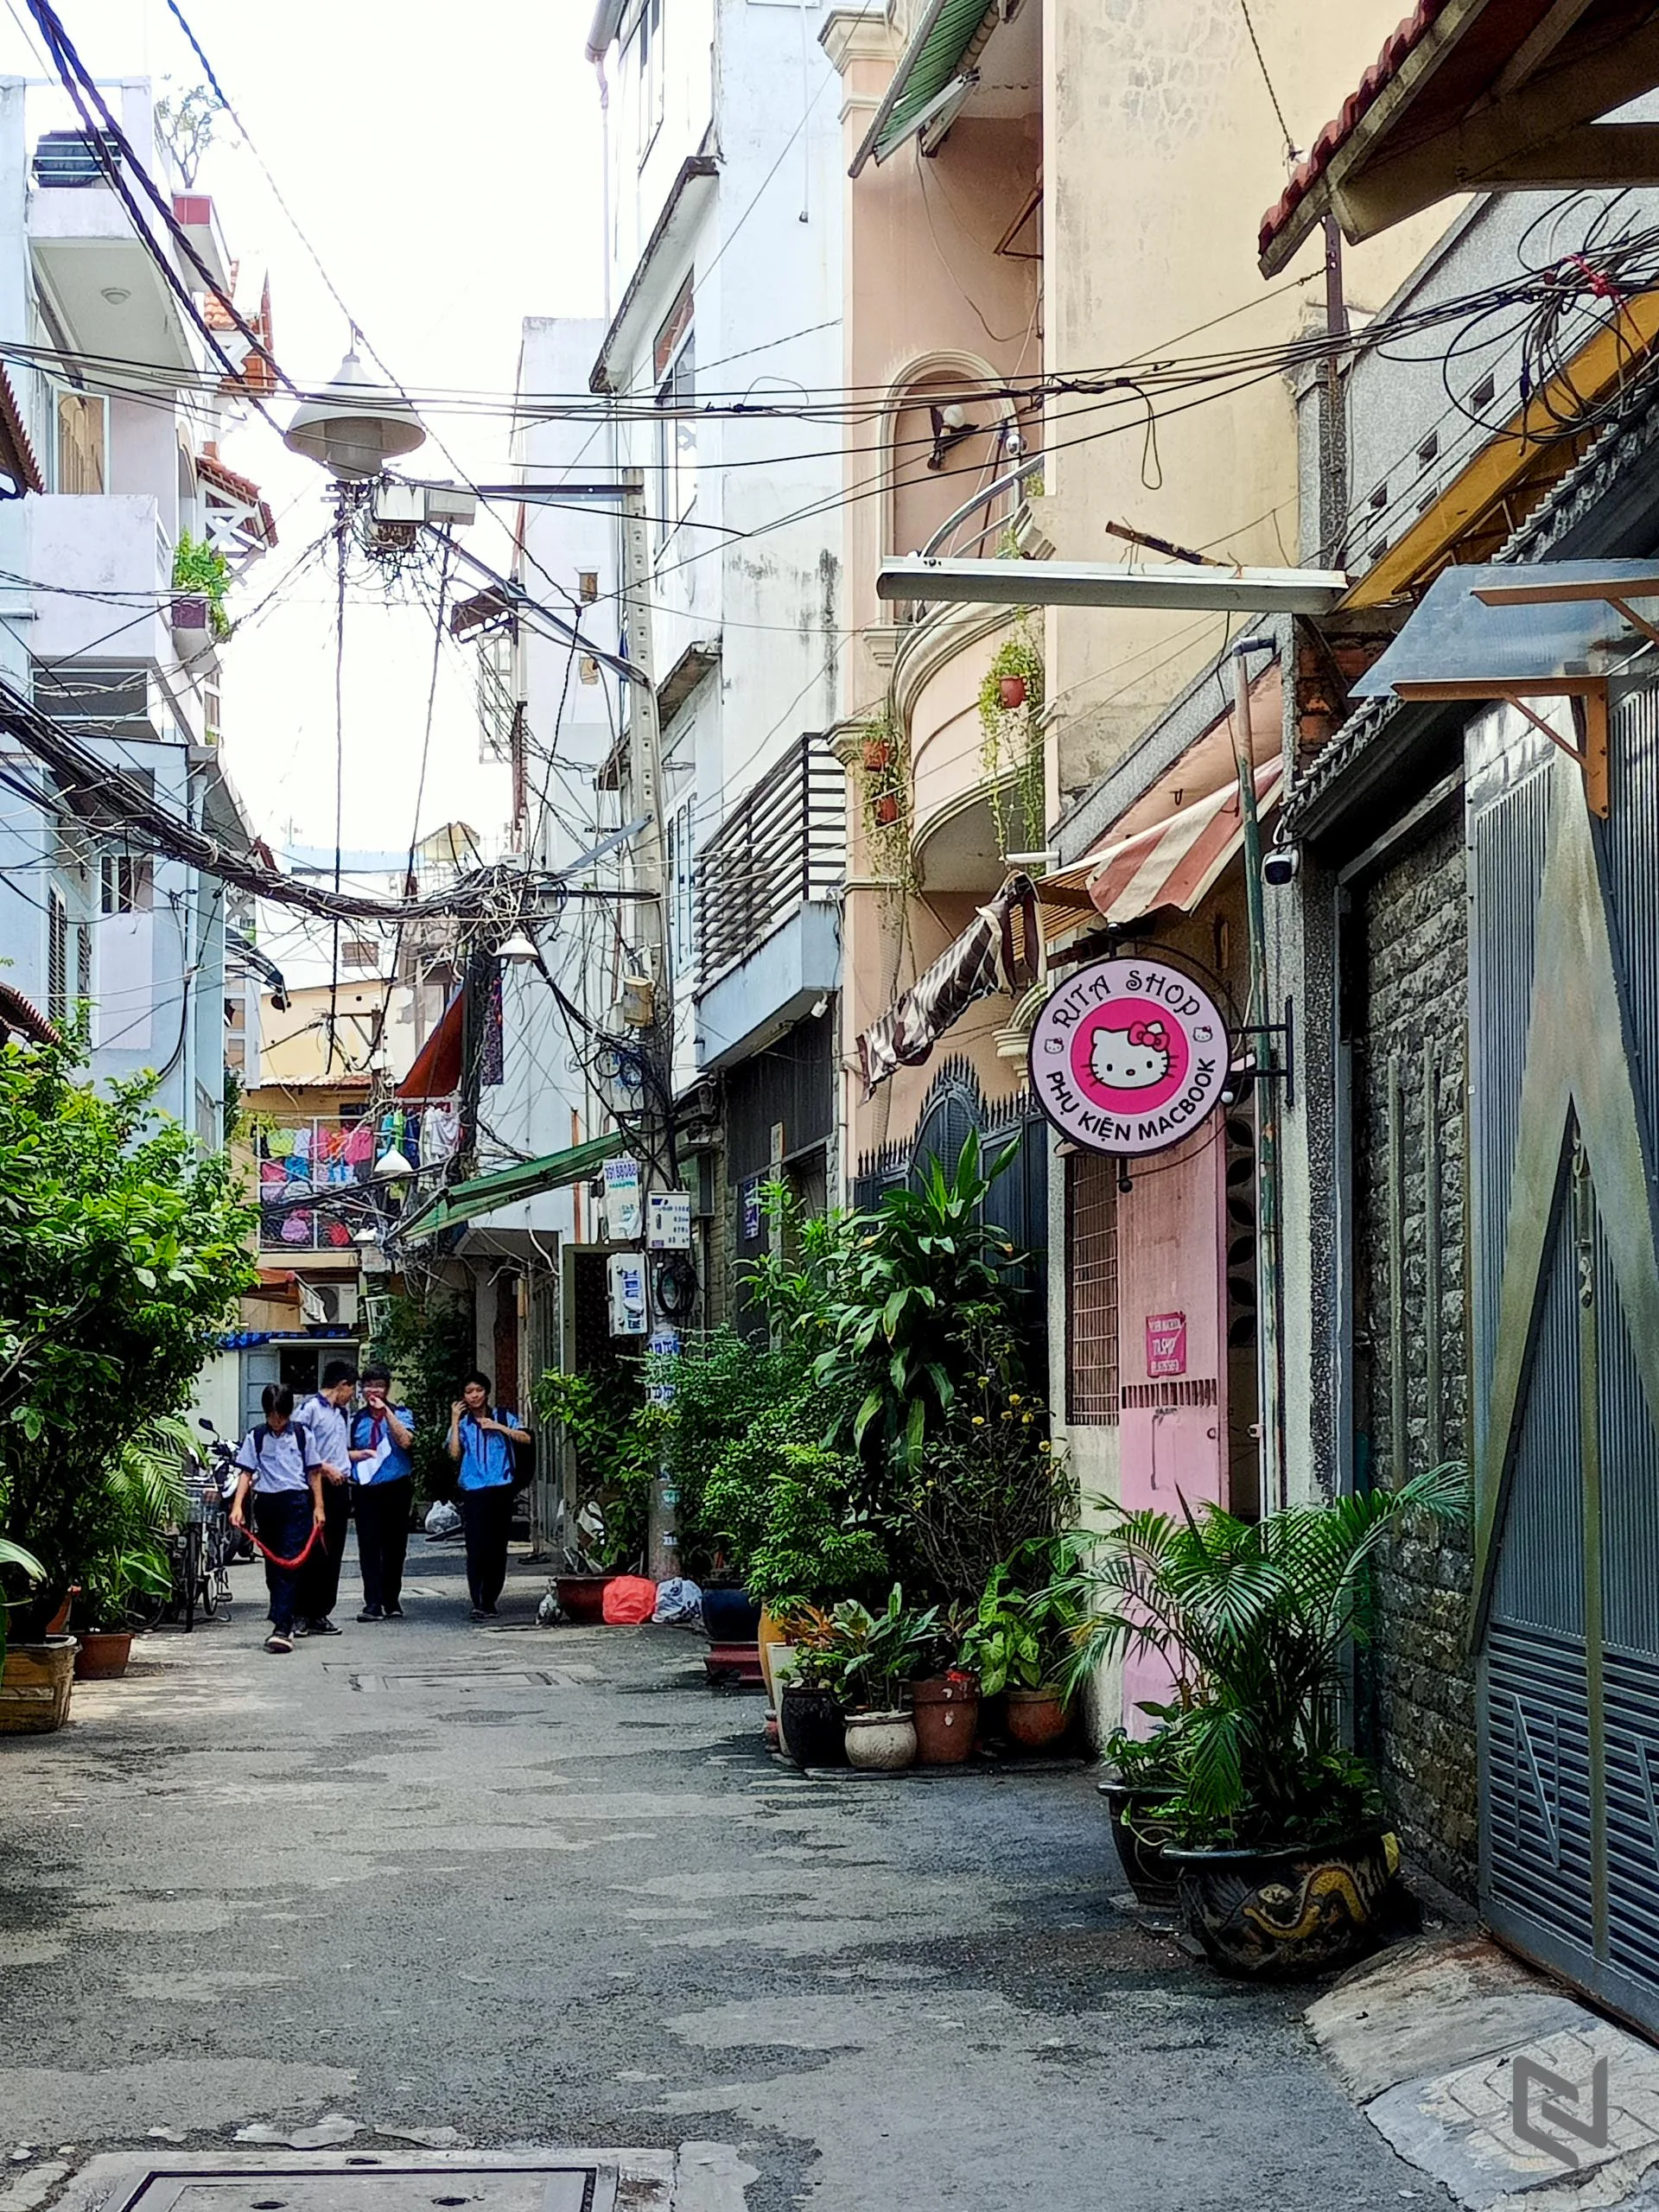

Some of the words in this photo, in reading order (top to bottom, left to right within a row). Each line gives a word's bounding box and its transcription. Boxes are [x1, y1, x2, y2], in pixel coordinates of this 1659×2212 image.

[1052, 976, 1111, 1028] RITA
[1125, 969, 1200, 1016] SHOP
[1046, 1071, 1080, 1116] PHỤ
[1077, 1111, 1131, 1141] KIỆN
[1139, 1058, 1216, 1141] MACBOOK
